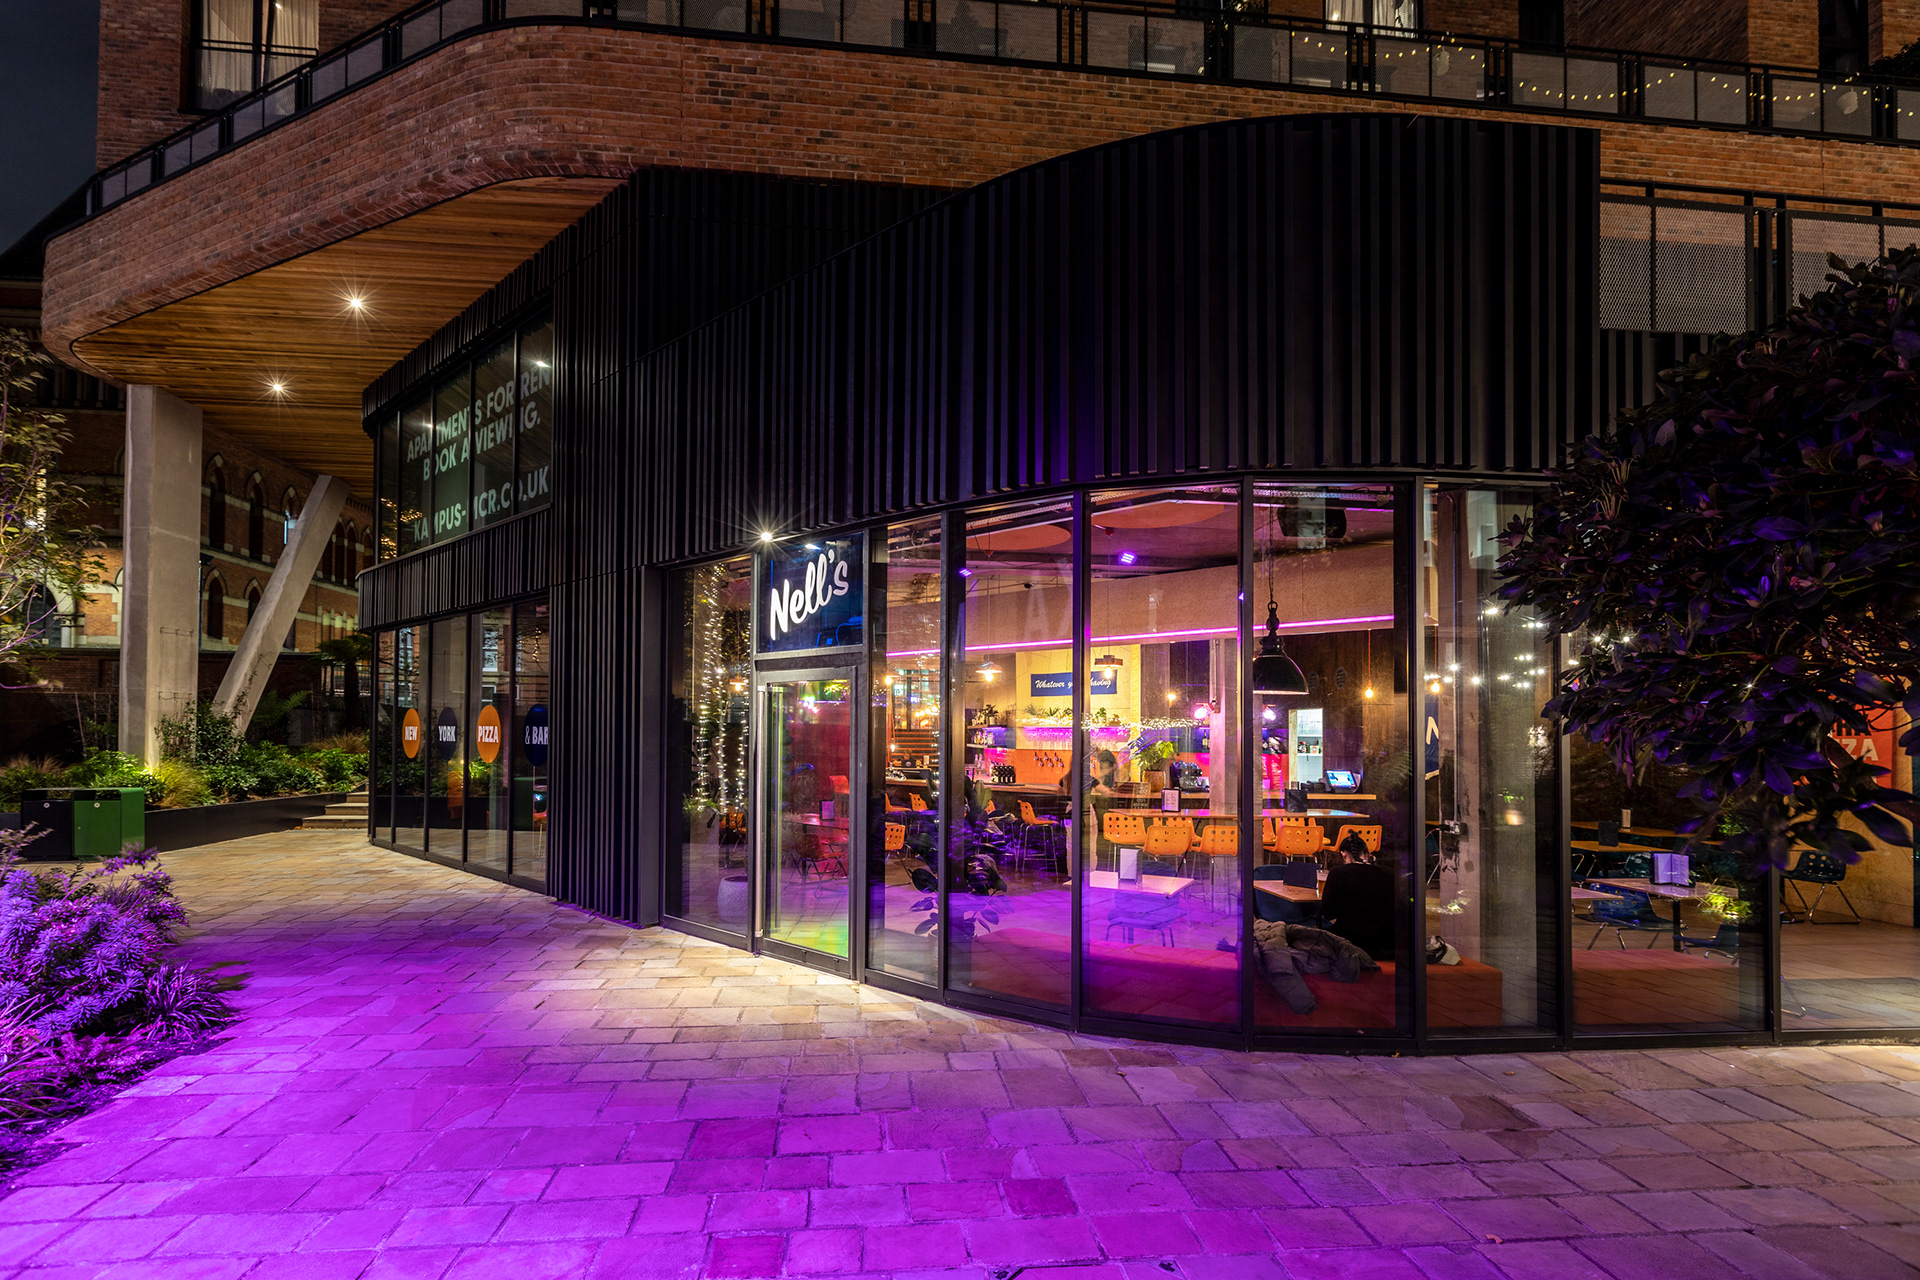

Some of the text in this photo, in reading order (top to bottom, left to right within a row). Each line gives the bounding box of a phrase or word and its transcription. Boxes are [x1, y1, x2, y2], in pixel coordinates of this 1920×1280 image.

[407, 366, 550, 463] APATMENS FOR REN
[460, 437, 470, 464] A
[770, 549, 849, 641] Nell's
[1035, 680, 1065, 689] Whatever
[404, 725, 548, 745] NEW YORK PIZZA & BAR
